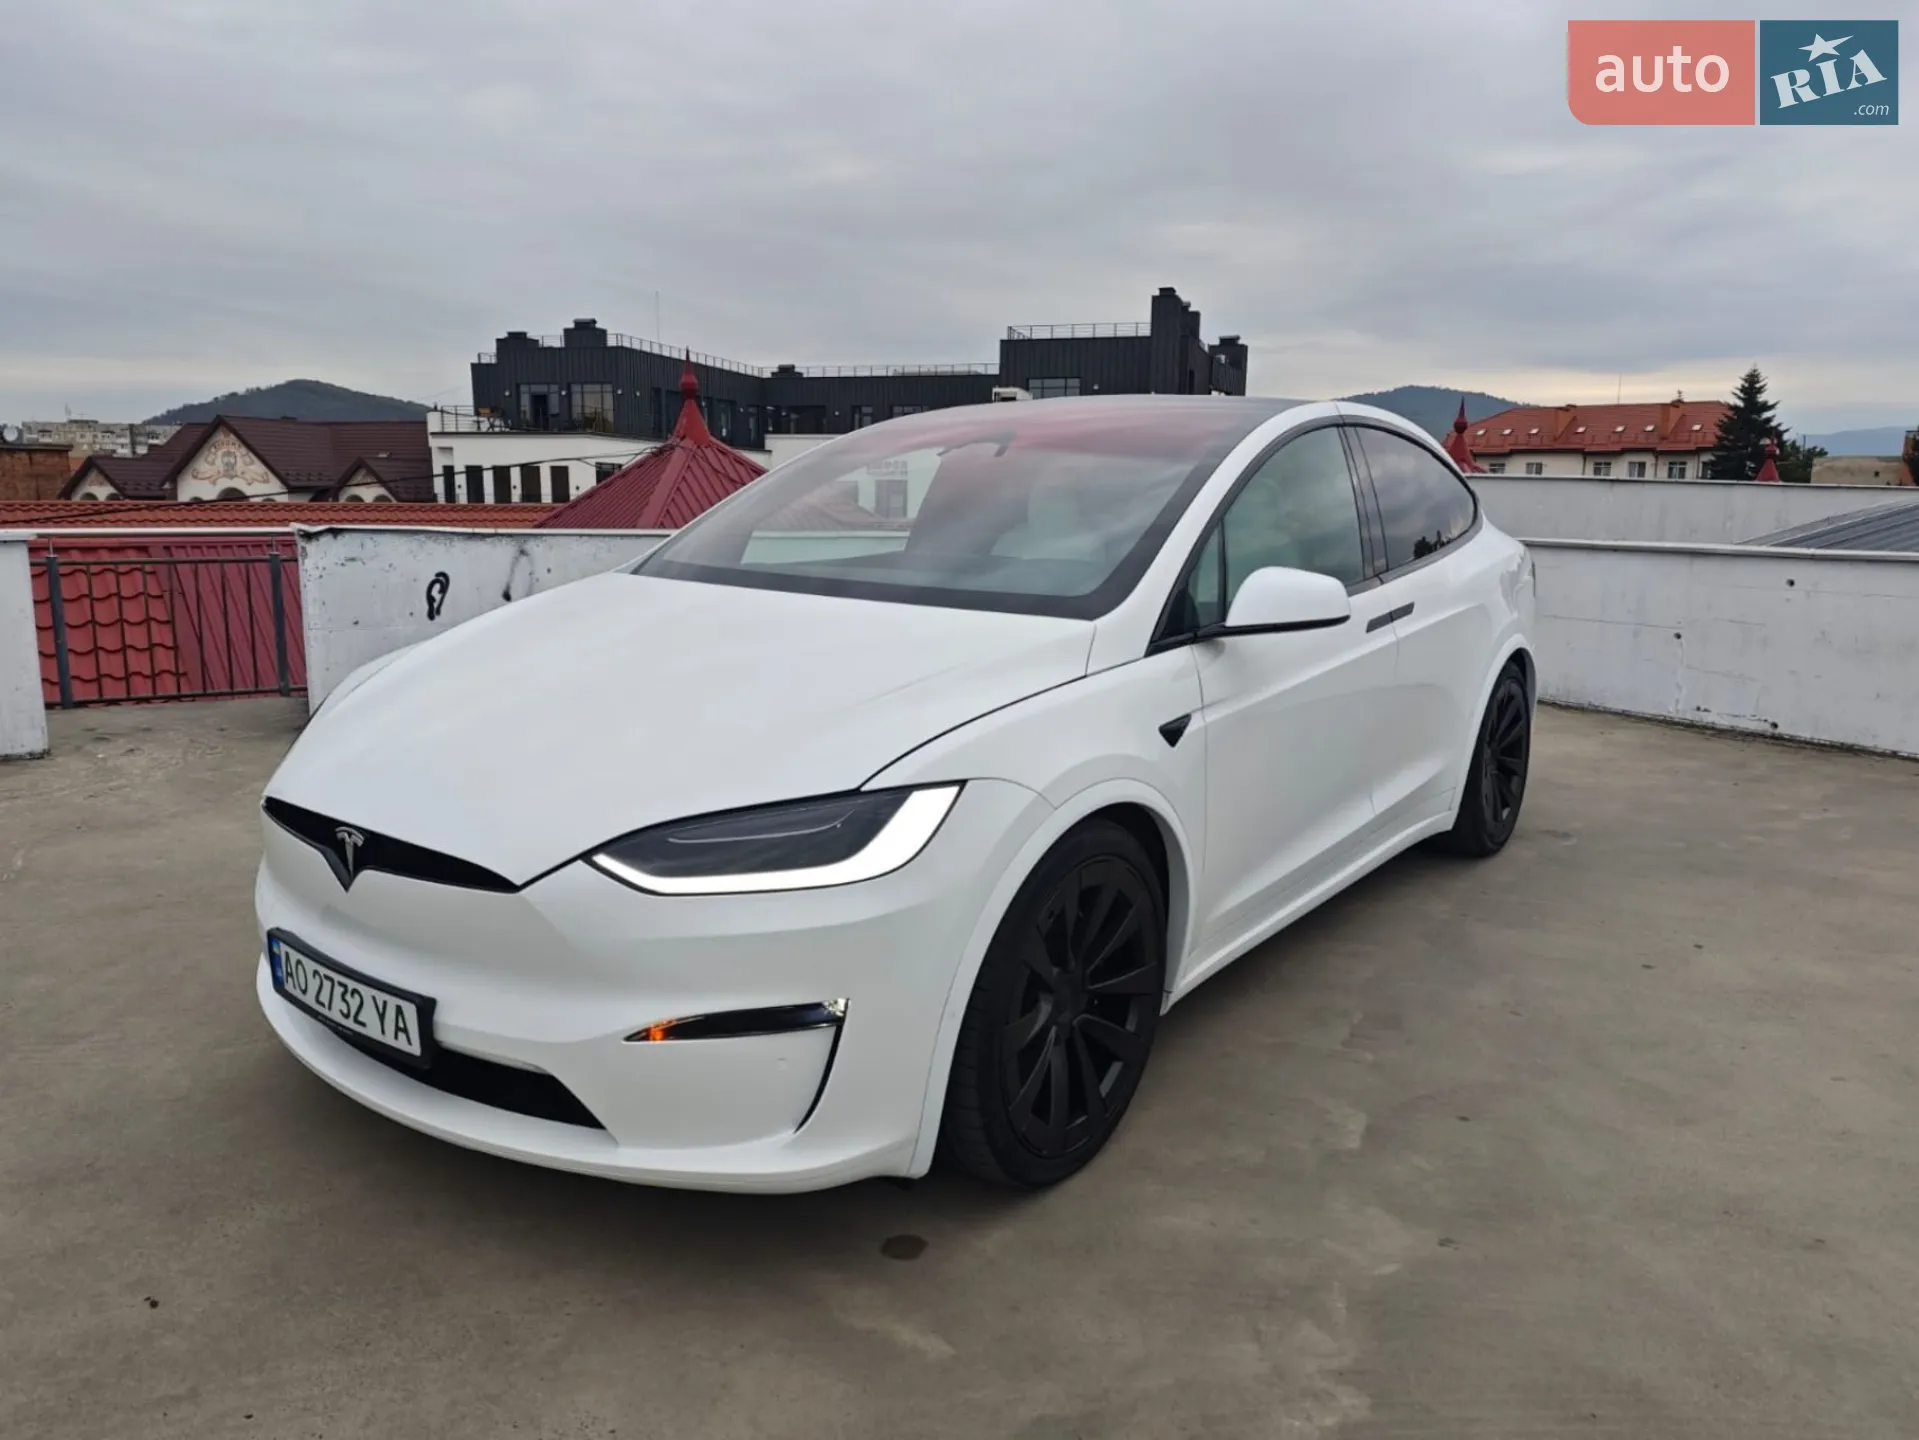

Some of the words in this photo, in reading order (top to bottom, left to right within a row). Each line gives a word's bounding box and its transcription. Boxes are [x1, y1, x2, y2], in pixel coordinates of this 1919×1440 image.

[285, 951, 308, 996] AO
[312, 969, 367, 1028] 2732
[371, 995, 413, 1046] YA
